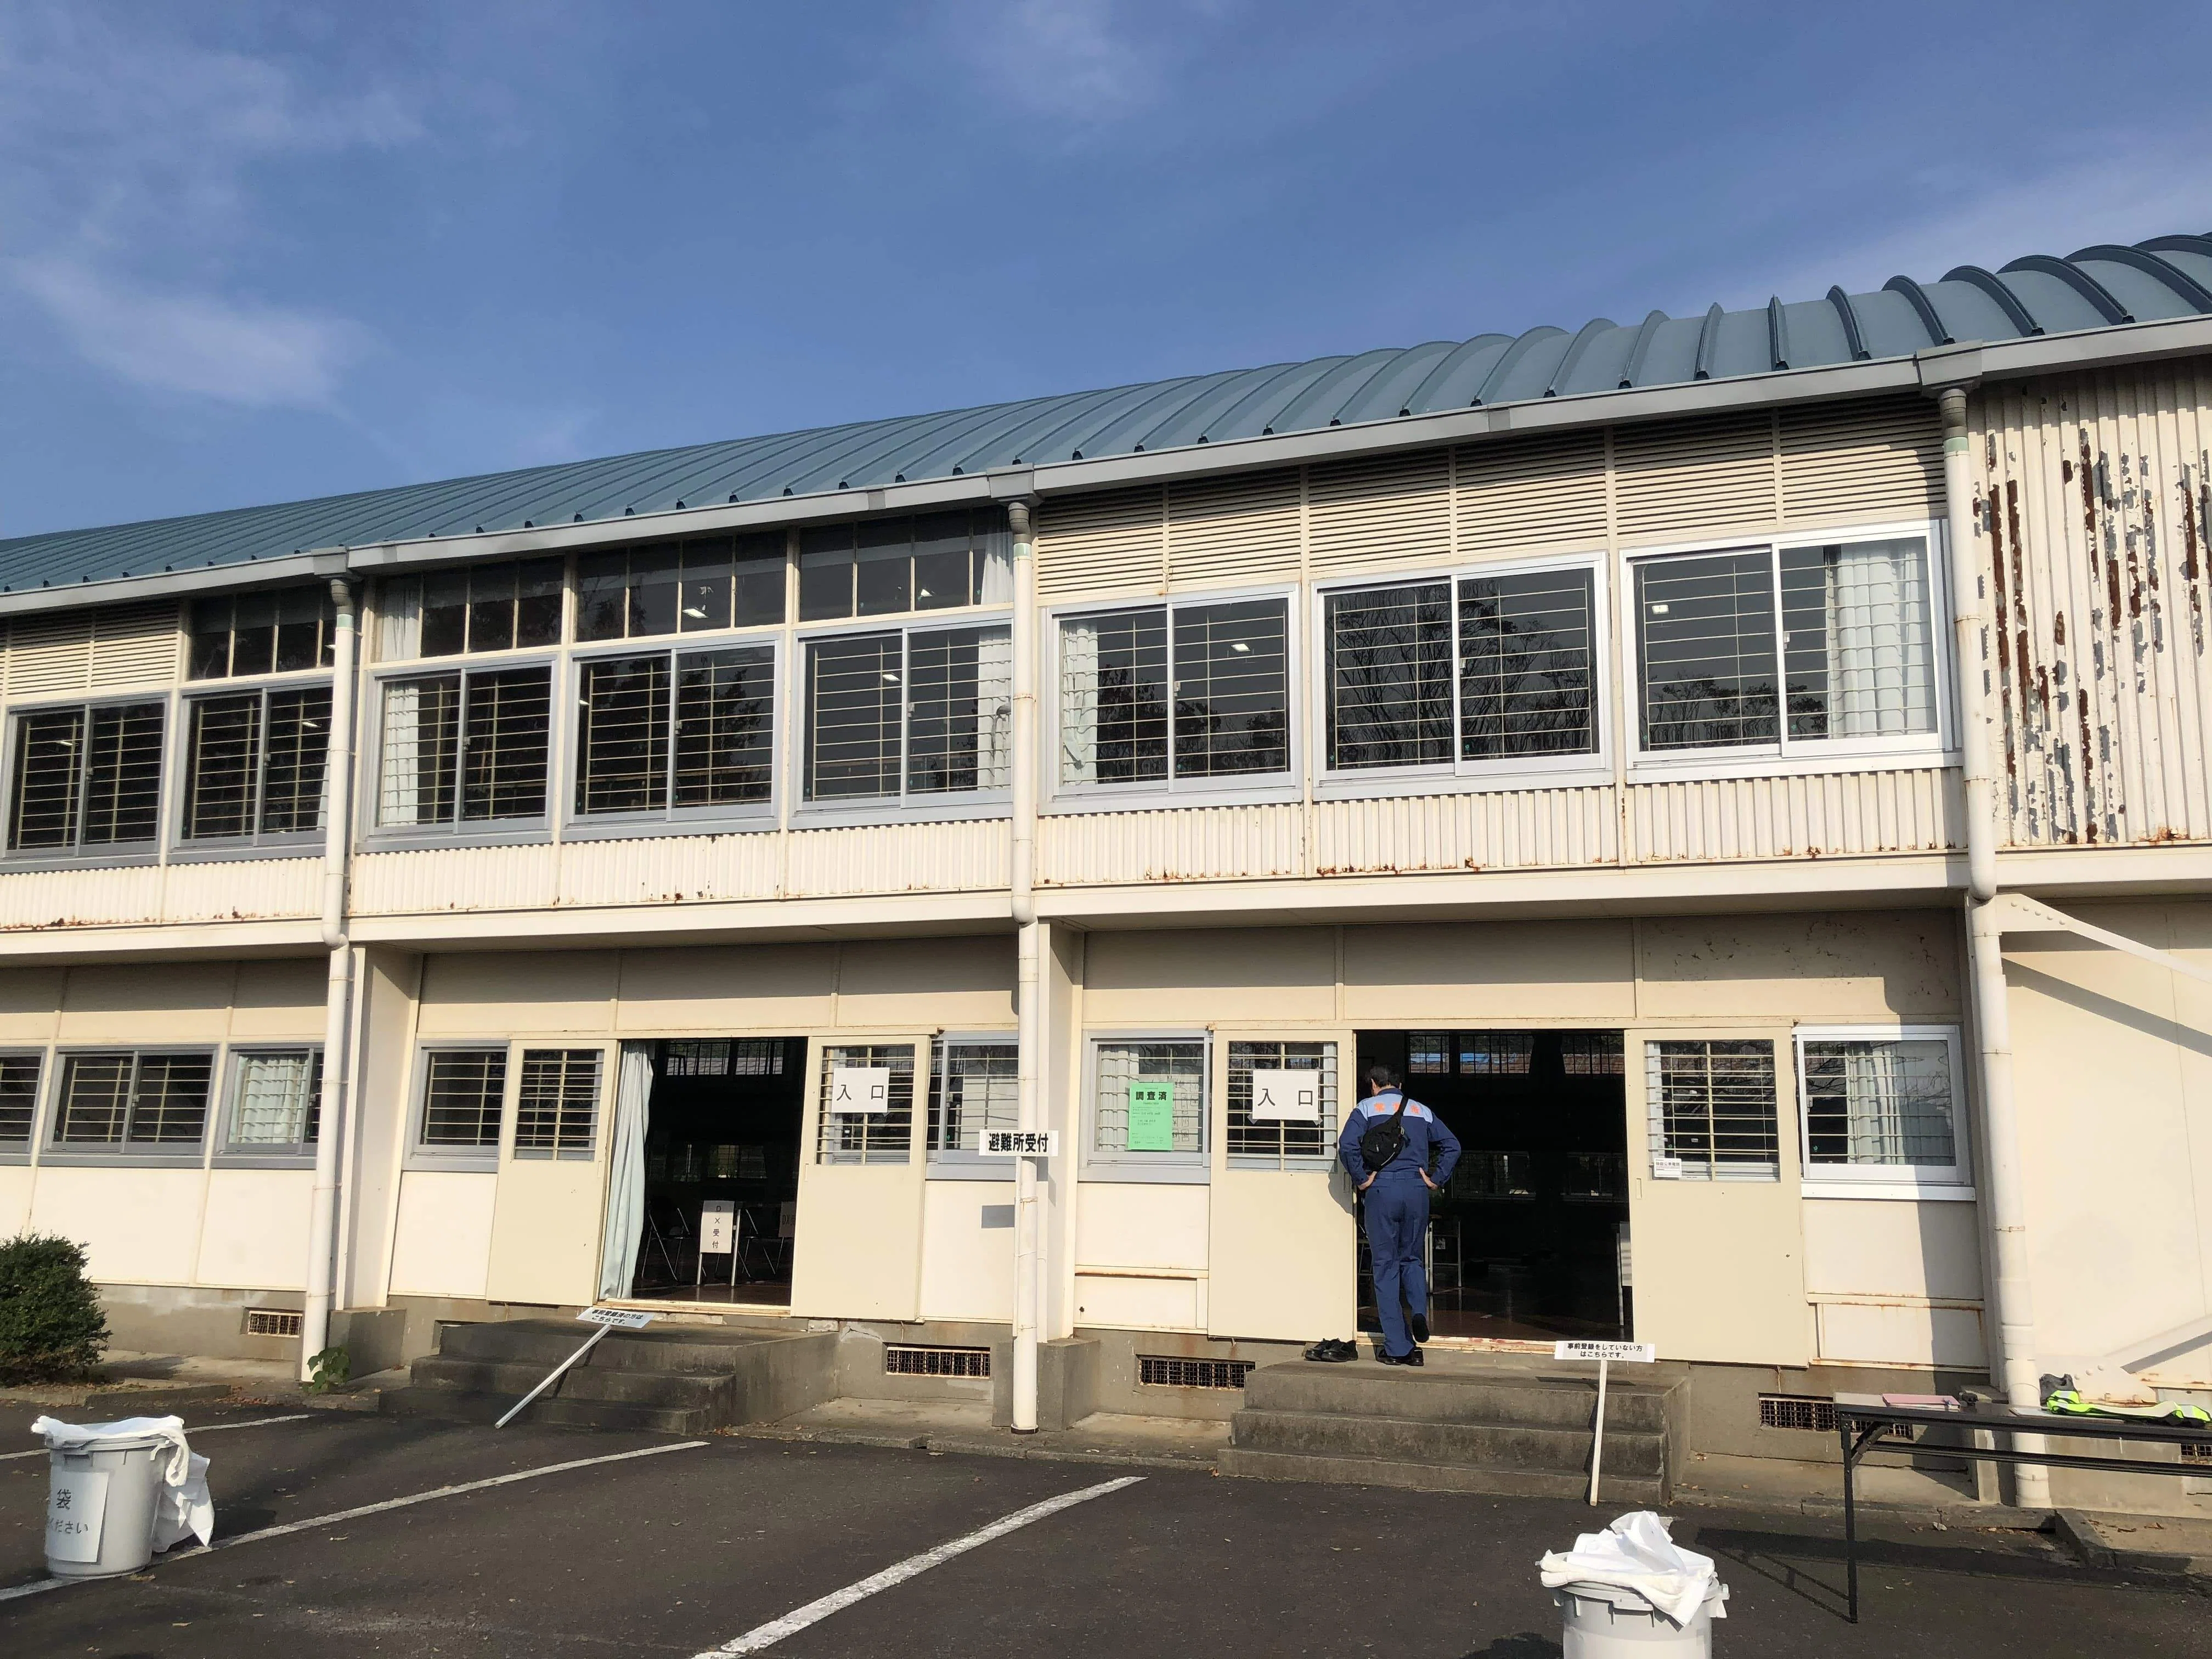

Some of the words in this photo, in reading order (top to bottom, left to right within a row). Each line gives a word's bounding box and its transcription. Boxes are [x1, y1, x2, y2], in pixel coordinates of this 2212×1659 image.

[837, 1084, 884, 1101] 入口
[1136, 1091, 1167, 1101] 調査済
[1257, 1088, 1313, 1106] 入口
[989, 1132, 1048, 1153] 避難所受付
[1567, 1343, 1643, 1352] 事前登録をしていない方
[57, 1488, 71, 1510] 袋
